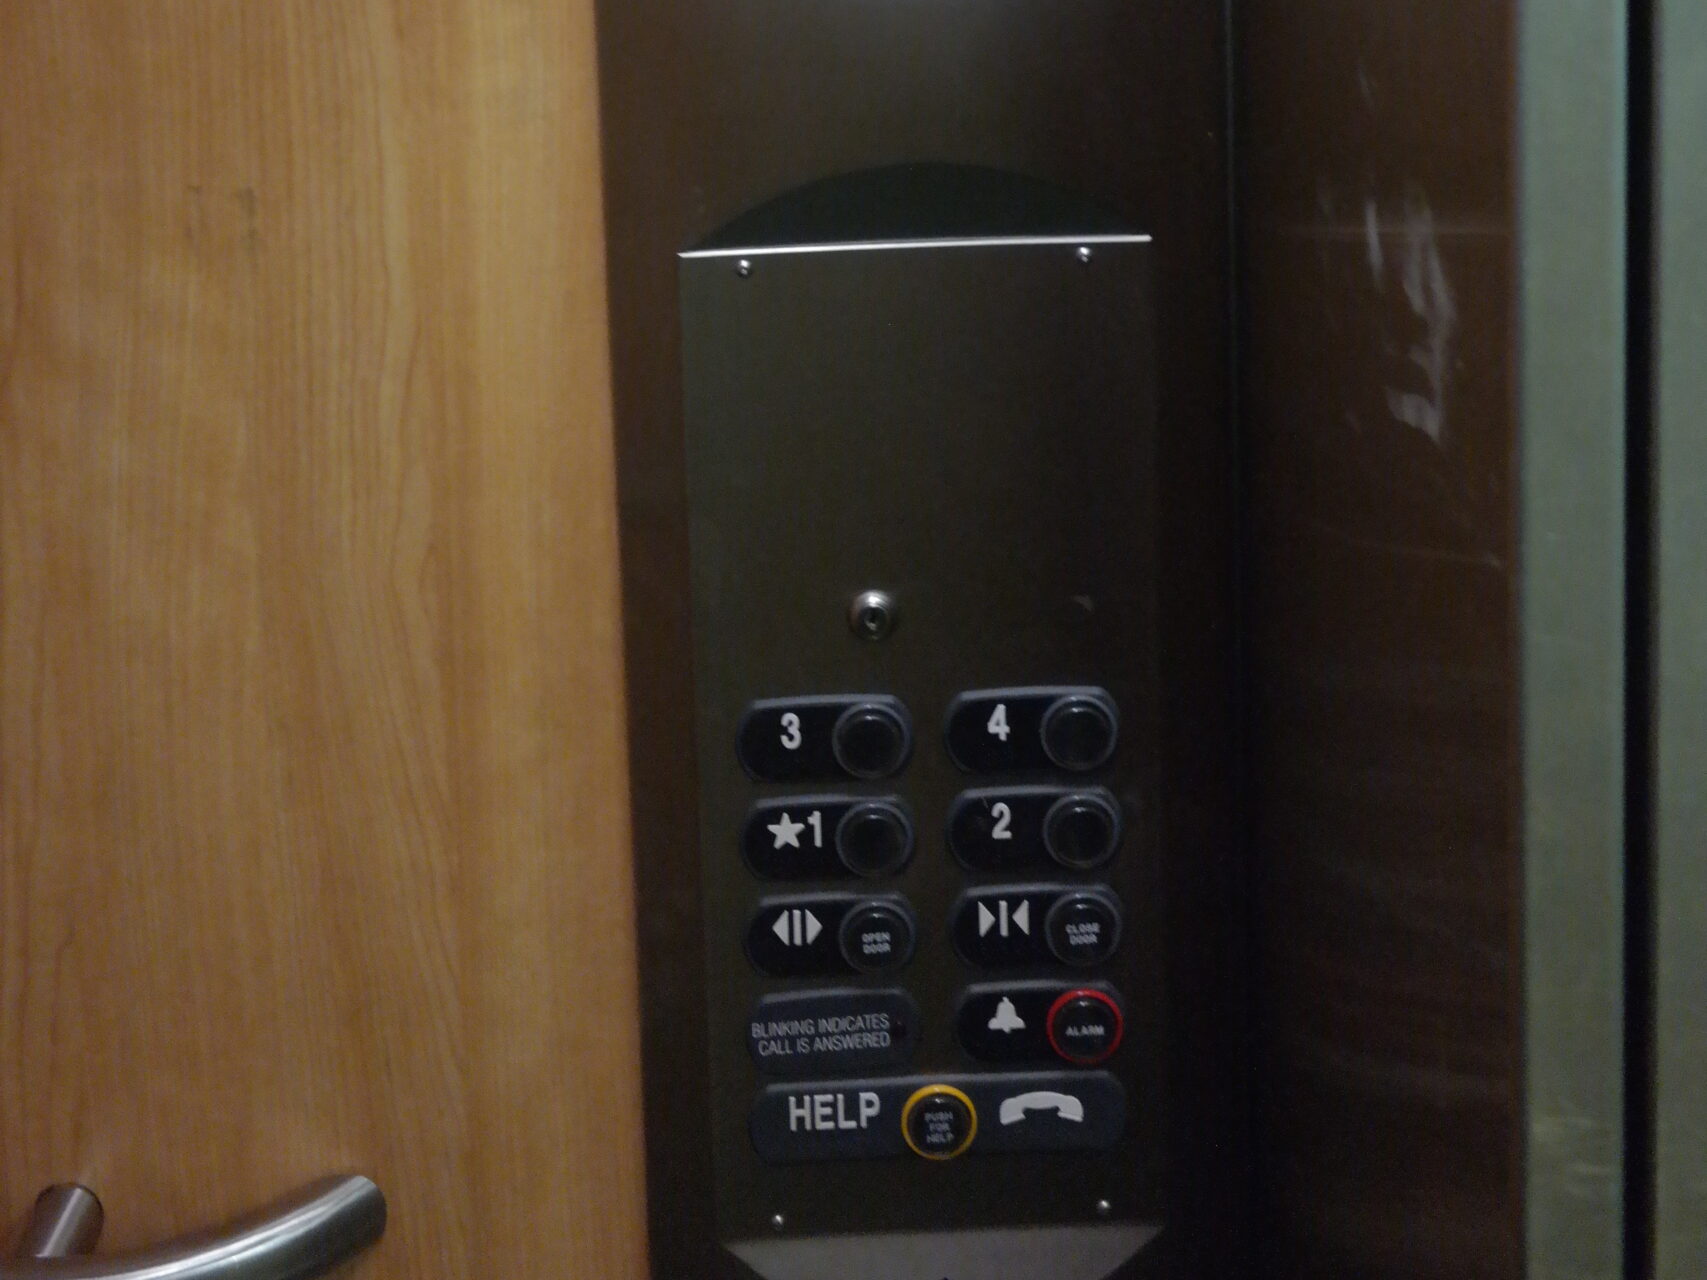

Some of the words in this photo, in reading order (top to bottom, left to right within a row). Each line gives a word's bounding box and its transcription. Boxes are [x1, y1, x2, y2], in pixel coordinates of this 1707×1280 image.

[780, 712, 802, 750] 3
[987, 704, 1010, 741] 4
[807, 810, 823, 848] 1
[991, 802, 1012, 840] 2
[861, 932, 891, 943] OPEN
[863, 942, 891, 955] DOOR
[751, 1020, 815, 1038] BLINKING
[818, 1013, 890, 1033] INDICATES
[1065, 1025, 1105, 1036] ALARM
[758, 1039, 793, 1056] CALL
[796, 1037, 810, 1054] IS
[813, 1031, 891, 1052] ANSWERED
[788, 1092, 881, 1132] HELP
